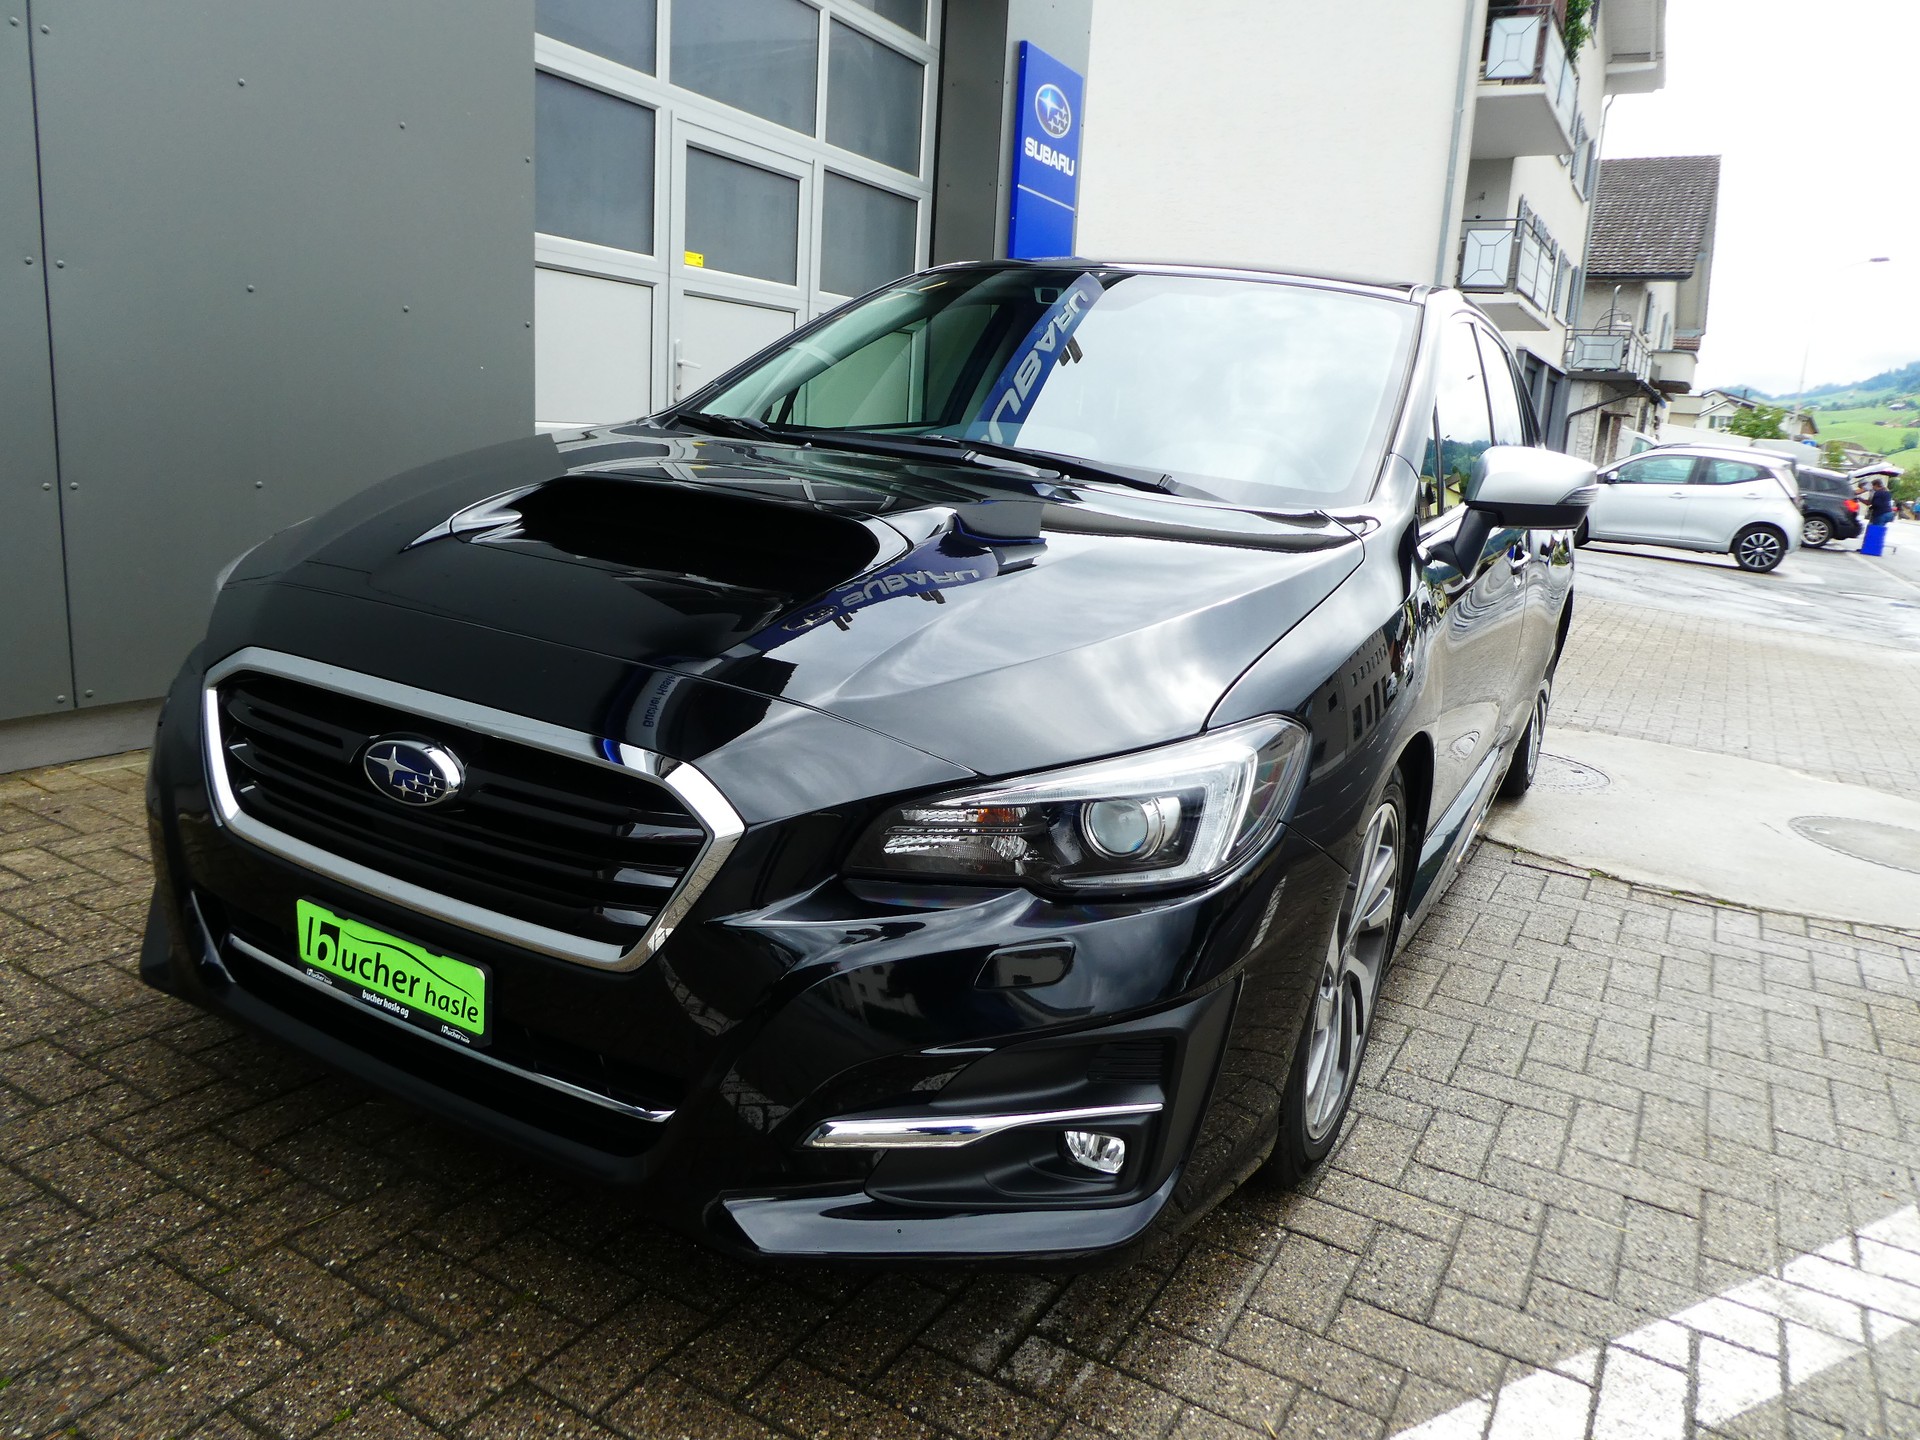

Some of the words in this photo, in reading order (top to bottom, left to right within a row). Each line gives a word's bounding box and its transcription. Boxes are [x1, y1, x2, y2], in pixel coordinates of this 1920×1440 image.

[1025, 137, 1074, 176] SUBARU
[306, 917, 420, 998] bucher
[424, 982, 479, 1023] hasle
[362, 989, 383, 1005] bucher
[383, 998, 401, 1013] hasle
[400, 1007, 409, 1018] ag
